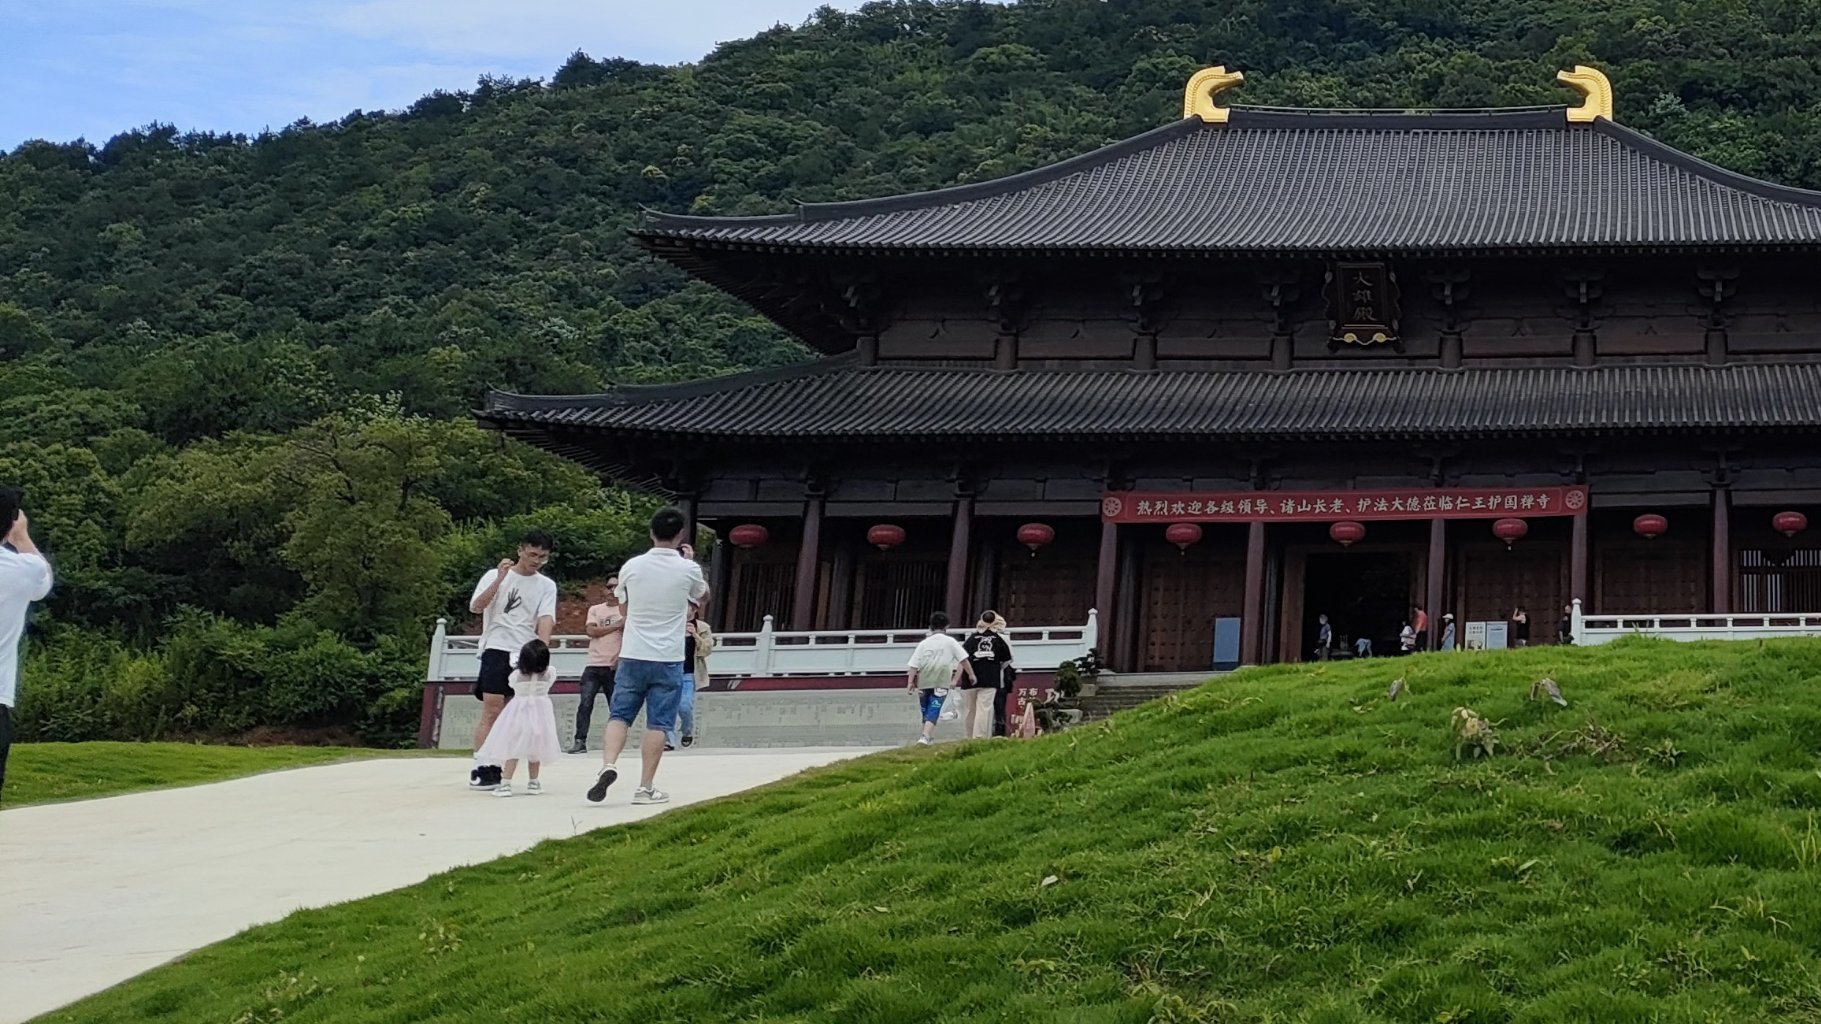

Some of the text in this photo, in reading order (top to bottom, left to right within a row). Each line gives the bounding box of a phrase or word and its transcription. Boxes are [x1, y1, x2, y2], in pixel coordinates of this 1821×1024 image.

[1137, 494, 1550, 516] 热烈欢迎各级领导、诸山长老、护法大德莅临仁王护国禅寺
